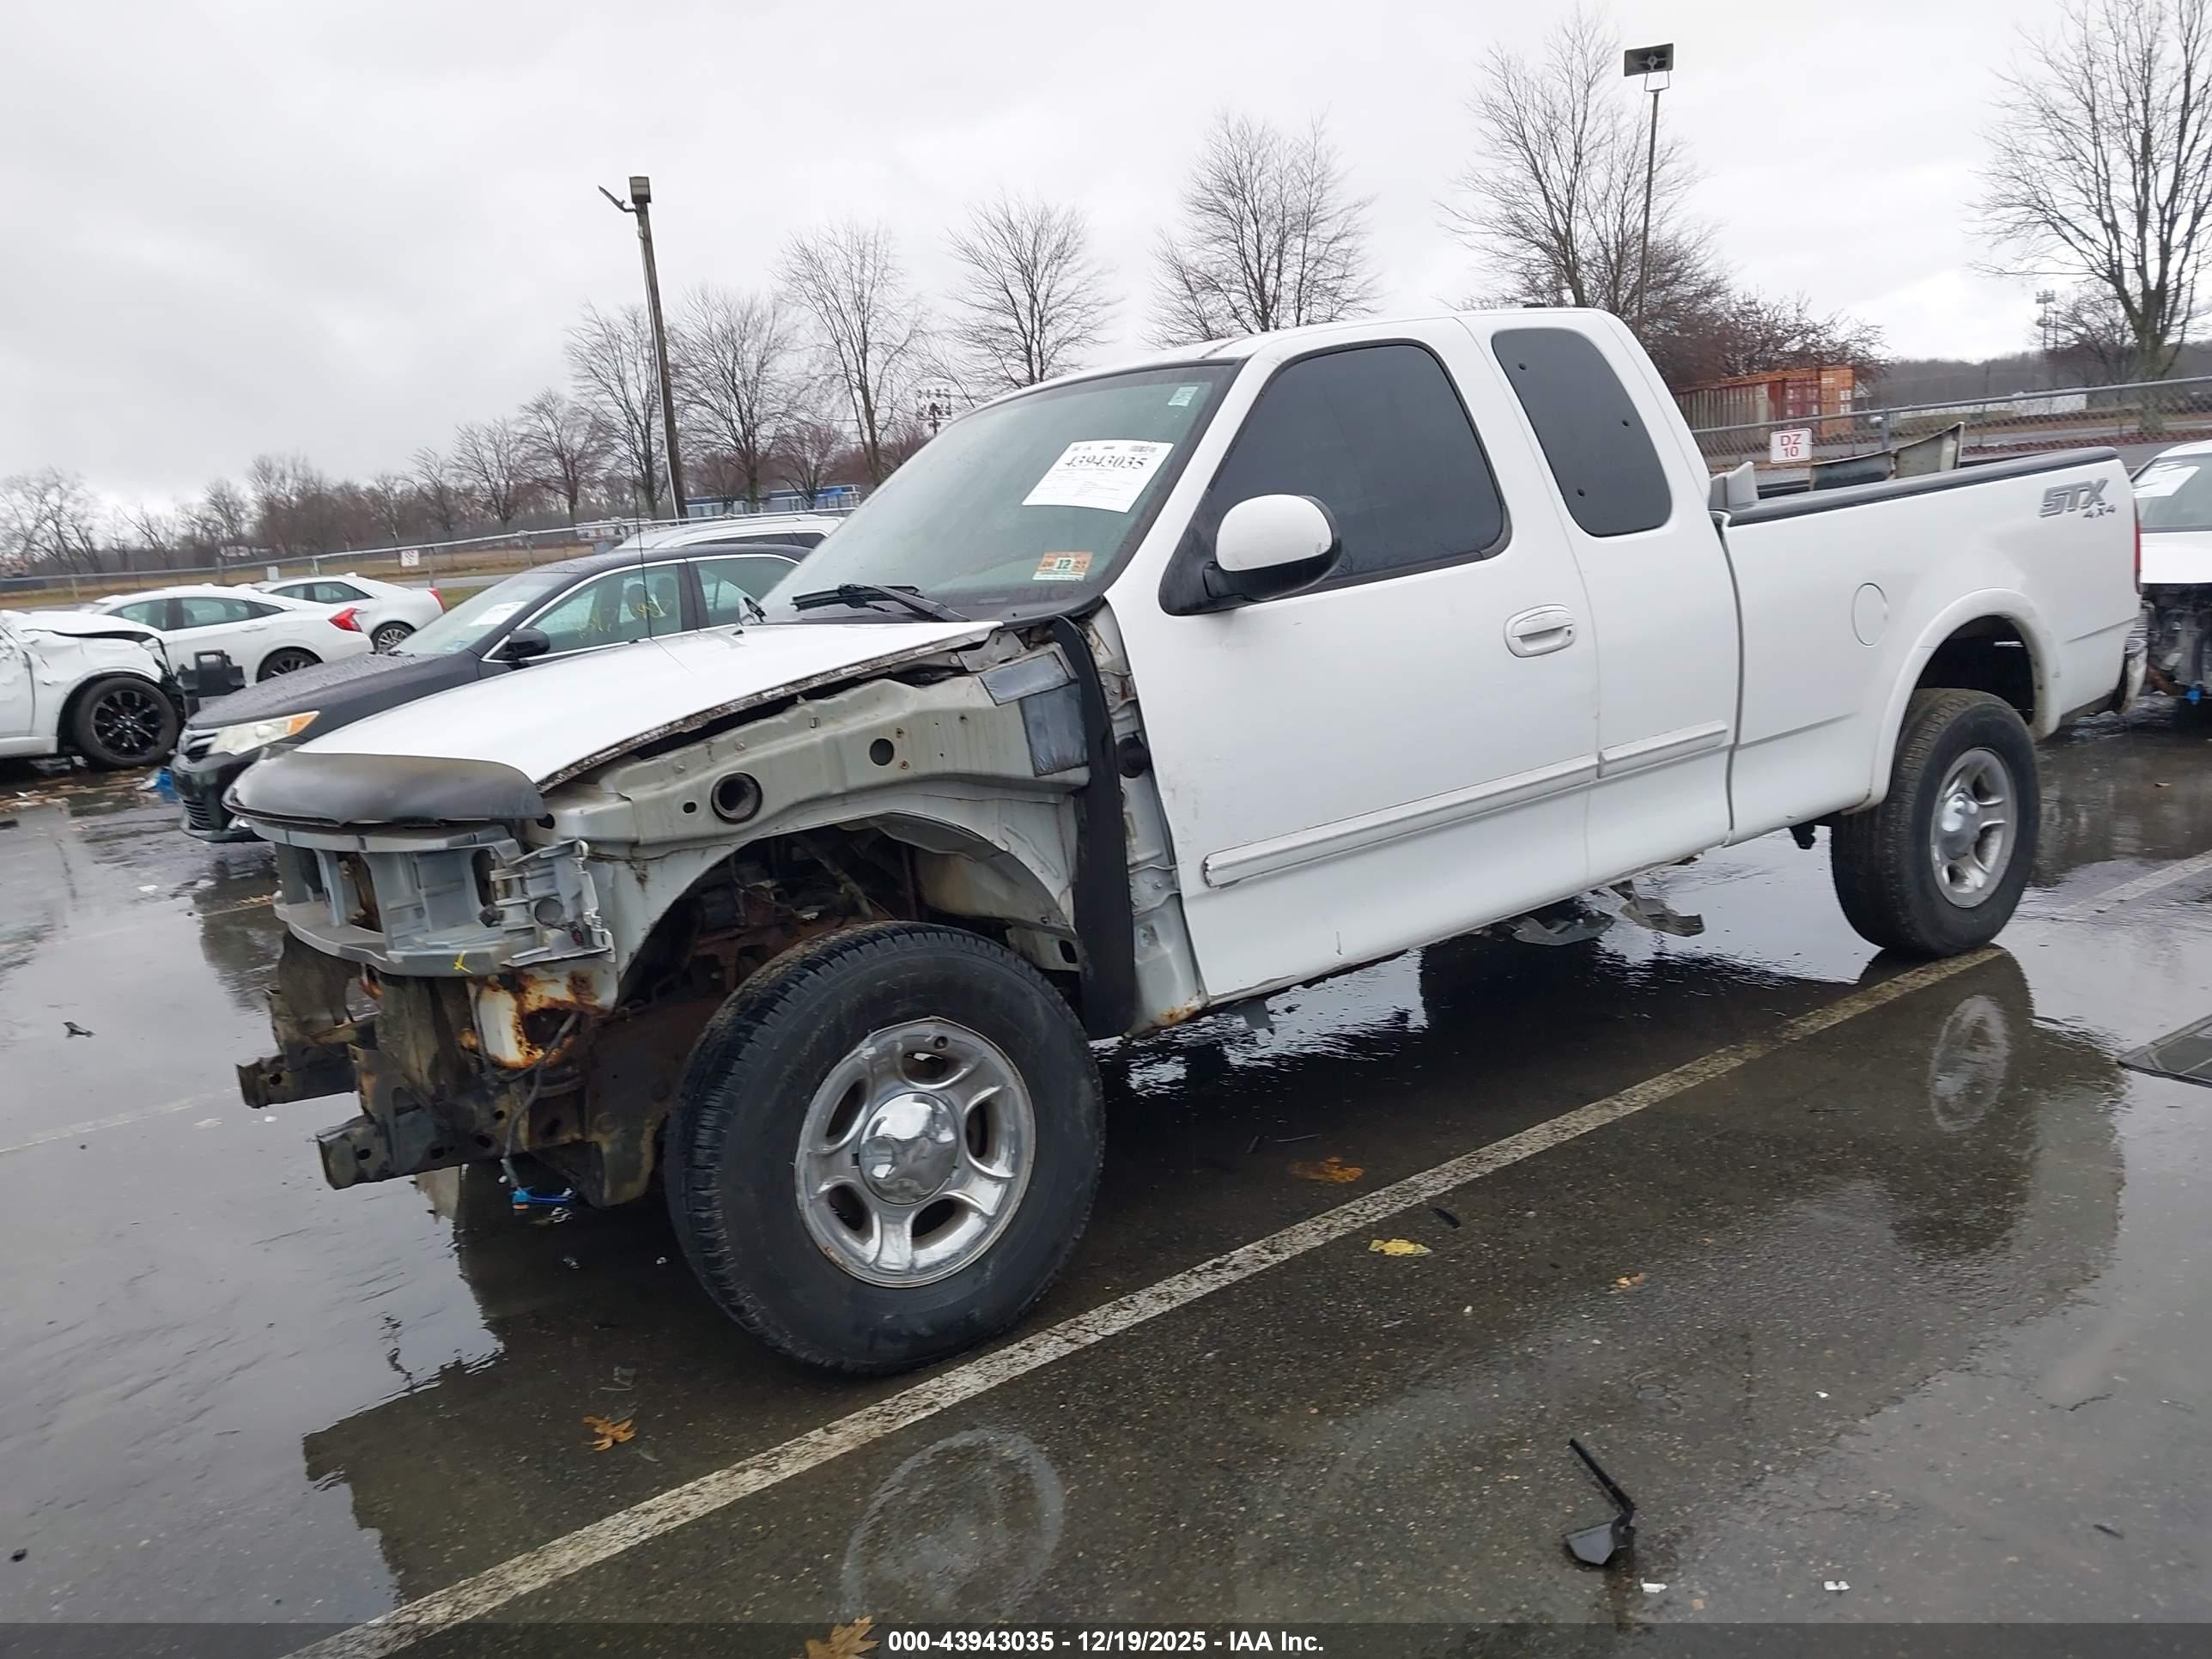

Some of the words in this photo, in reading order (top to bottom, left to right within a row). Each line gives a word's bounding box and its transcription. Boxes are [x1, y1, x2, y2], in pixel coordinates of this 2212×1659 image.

[1780, 434, 1802, 447] DZ
[1783, 446, 1800, 458] 10
[1065, 455, 1148, 470] 43943035
[2039, 477, 2109, 517] STX
[1056, 558, 1073, 570] 12
